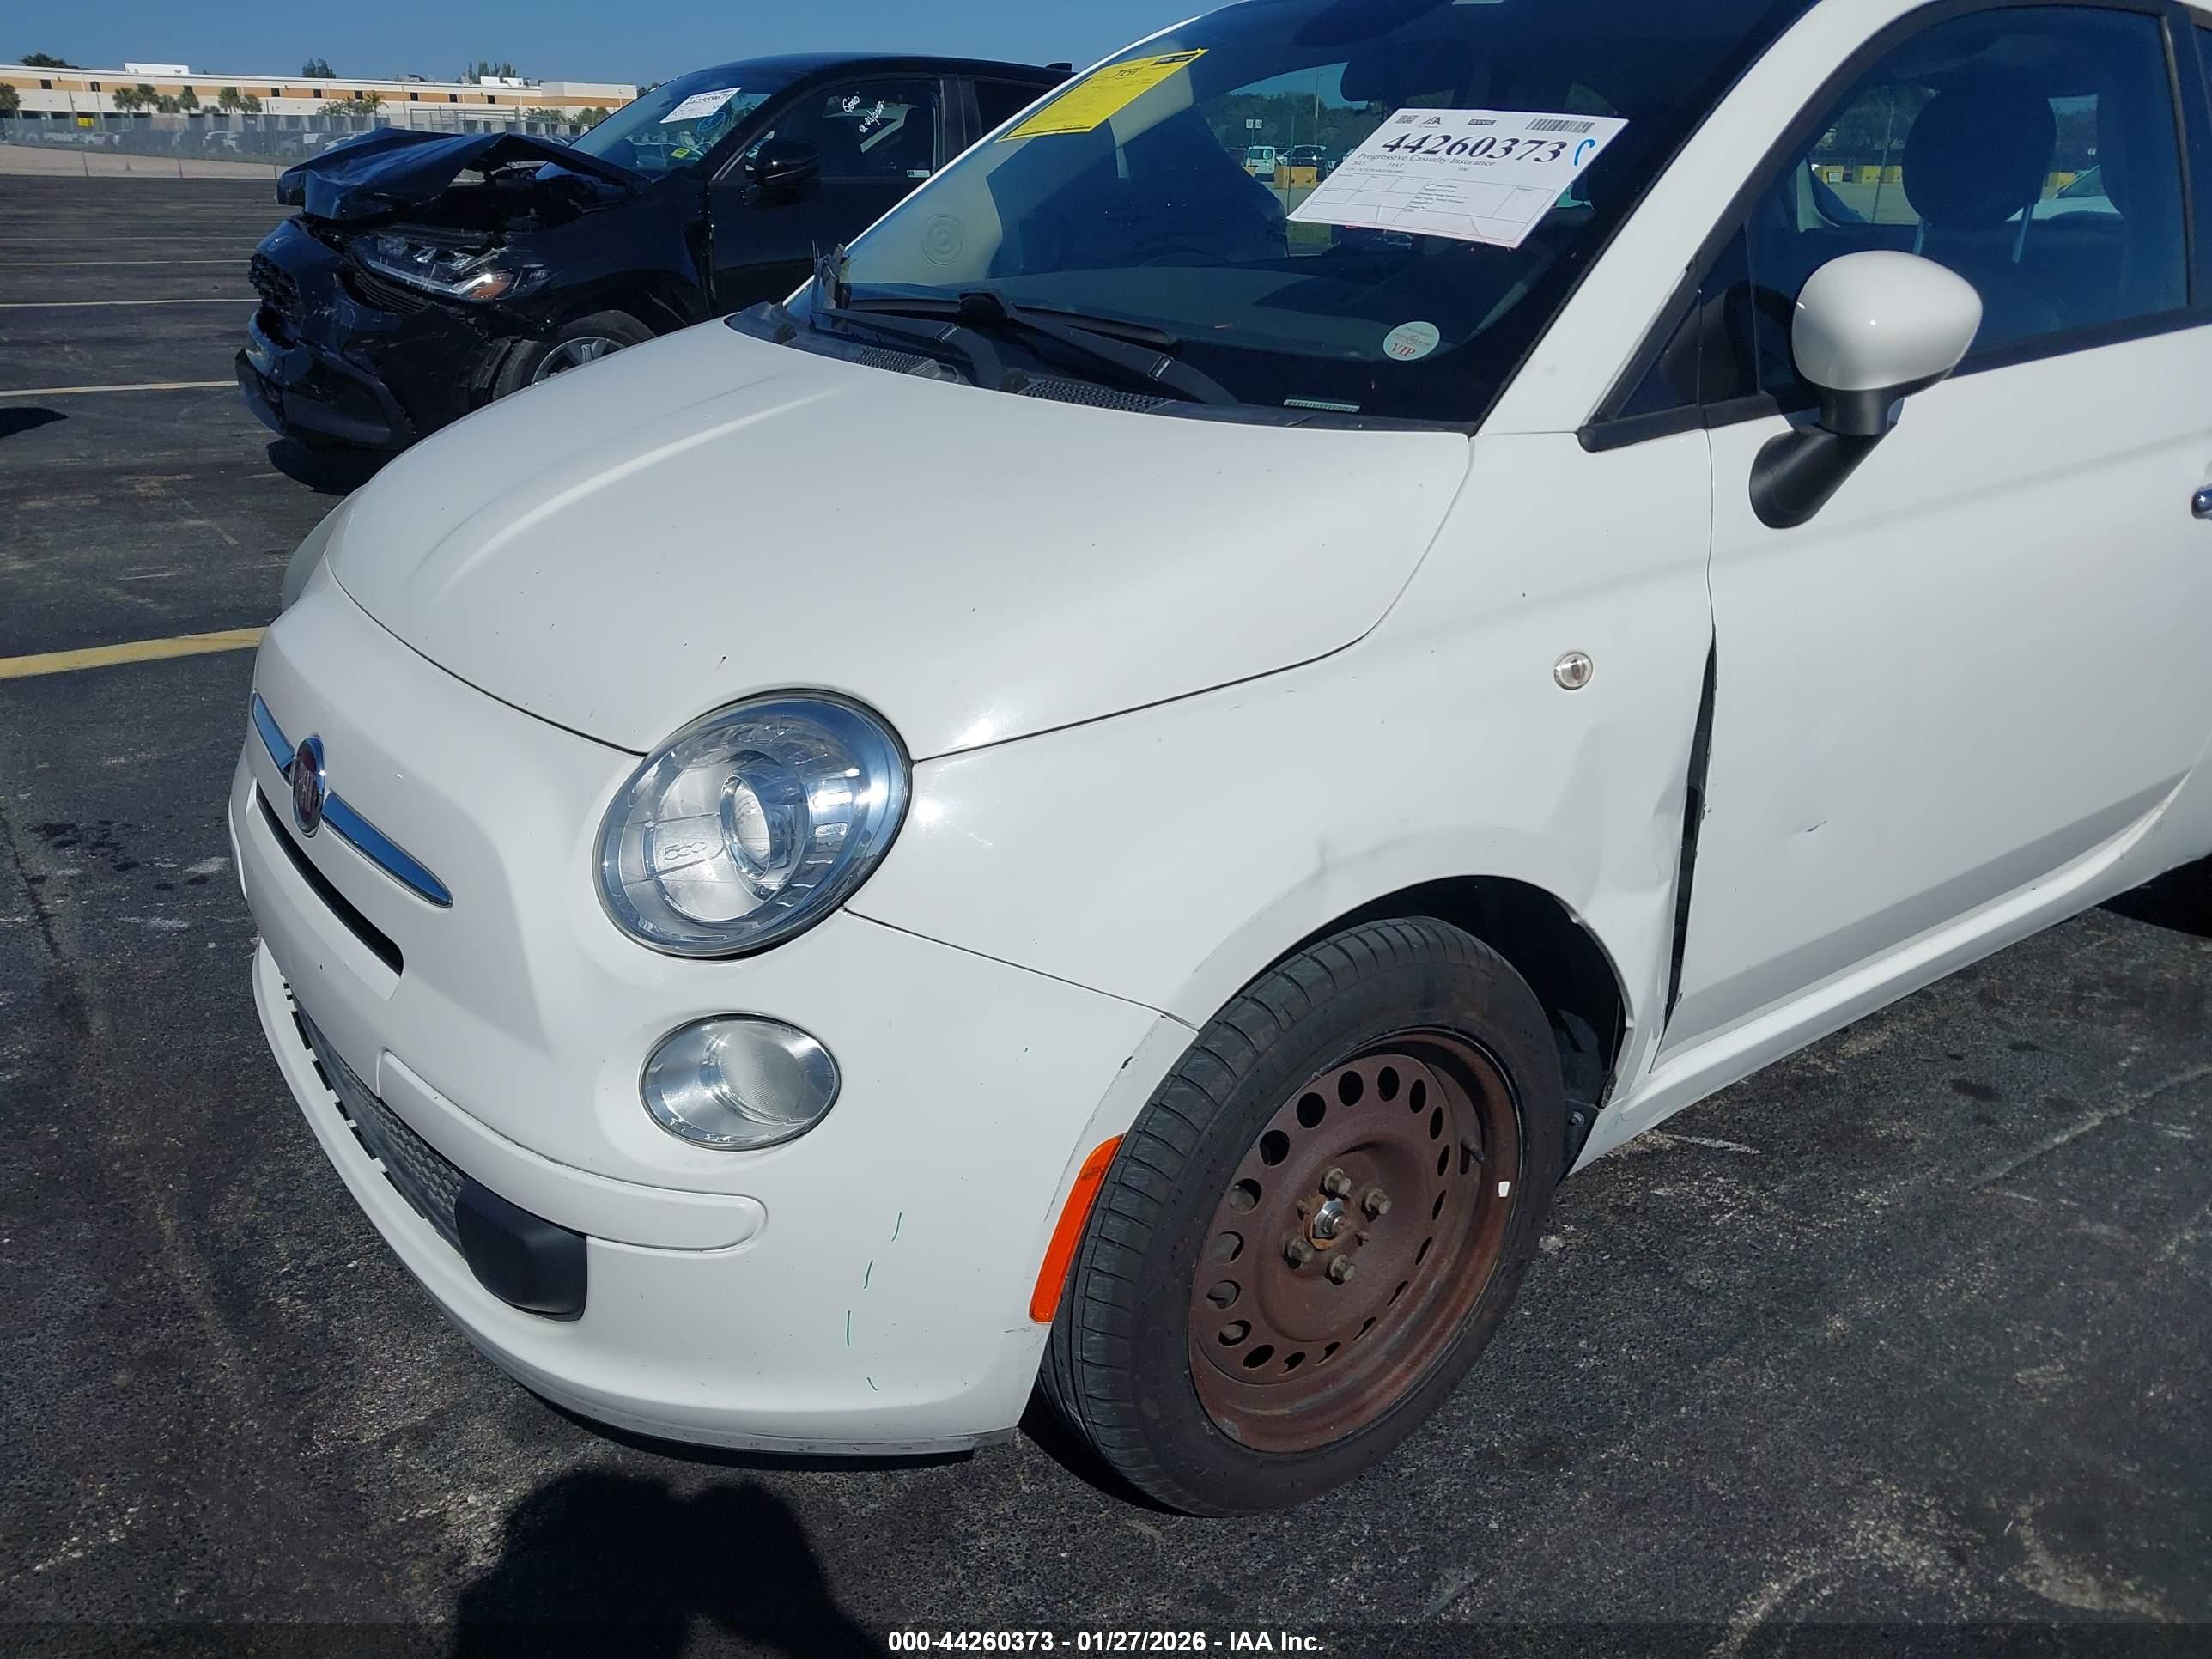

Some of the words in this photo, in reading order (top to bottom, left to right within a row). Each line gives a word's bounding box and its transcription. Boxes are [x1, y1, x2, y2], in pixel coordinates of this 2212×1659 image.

[1382, 133, 1567, 162] 44260373
[1357, 152, 1408, 161] Progressive
[1409, 155, 1447, 165] Casualty
[1449, 157, 1496, 166] Insurance
[1391, 343, 1416, 356] VIP
[663, 842, 707, 860] 500
